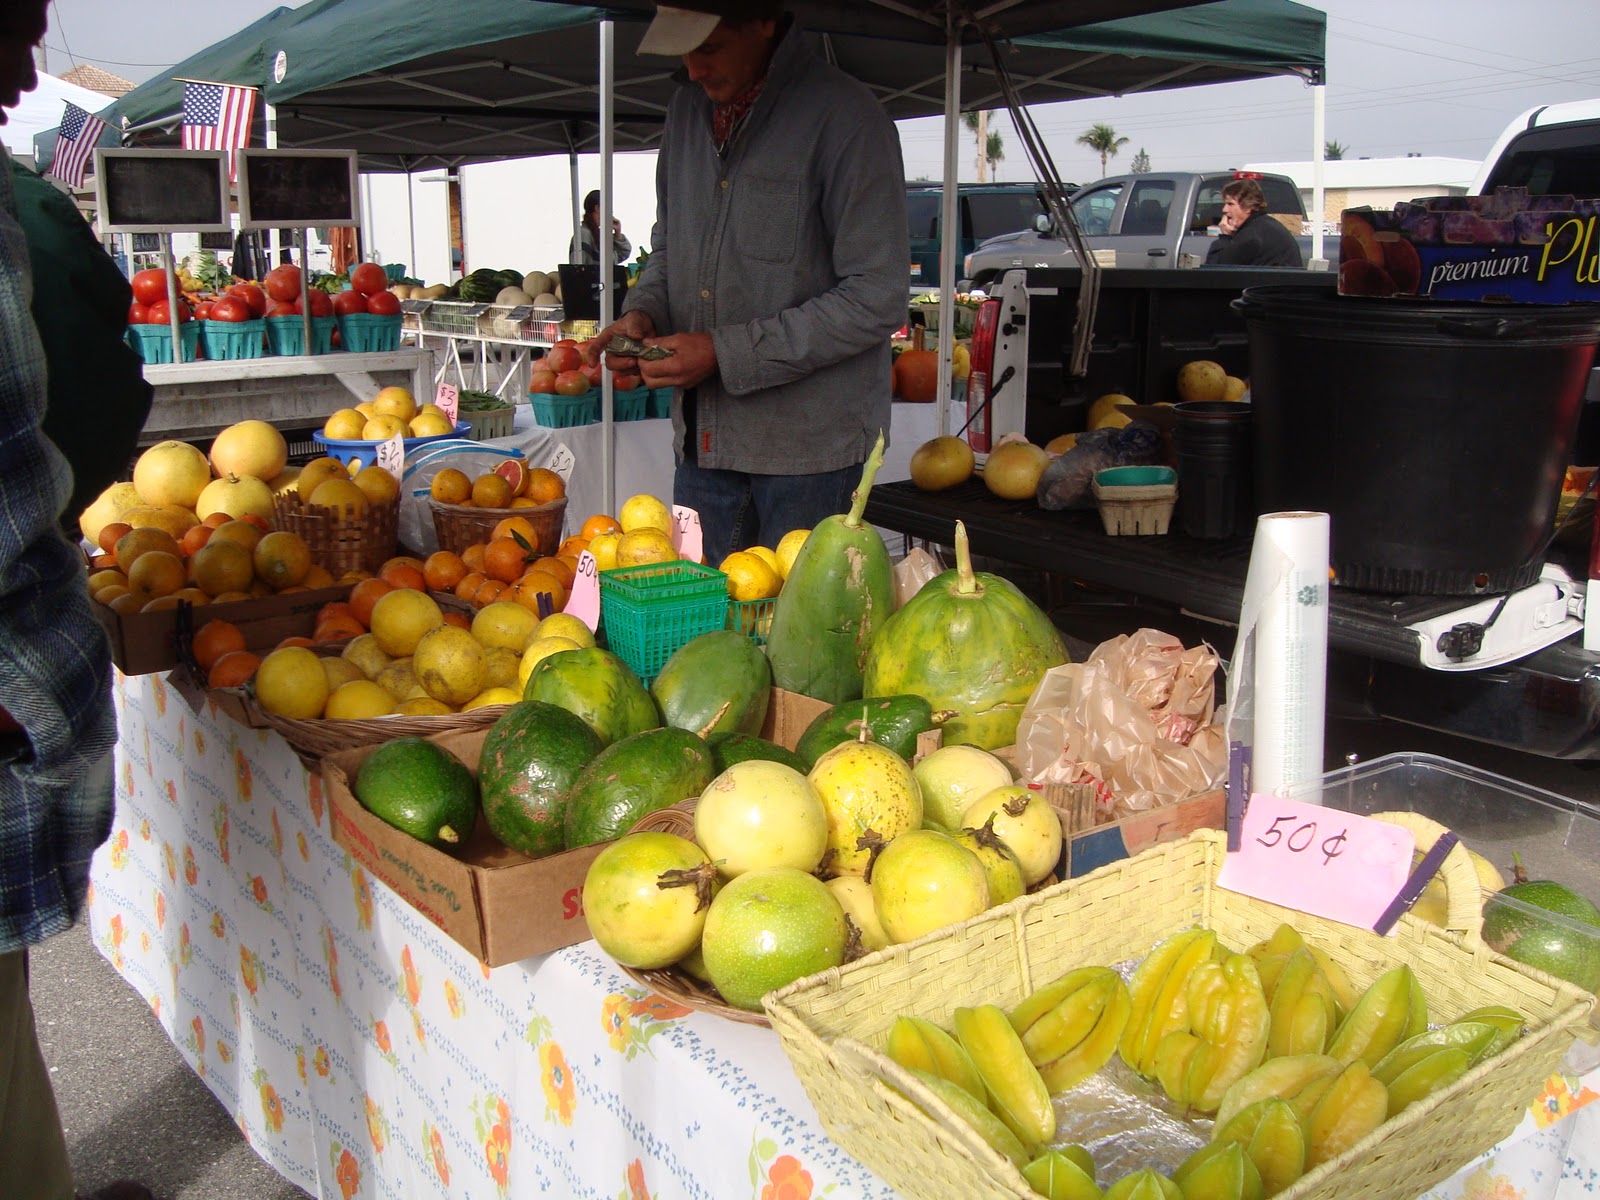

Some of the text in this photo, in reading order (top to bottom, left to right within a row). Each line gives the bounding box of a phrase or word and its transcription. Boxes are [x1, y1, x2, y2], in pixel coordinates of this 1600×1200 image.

[1428, 248, 1530, 294] premium
[440, 386, 456, 407] $3
[379, 441, 400, 464] $2
[1256, 815, 1348, 867] 50¢
